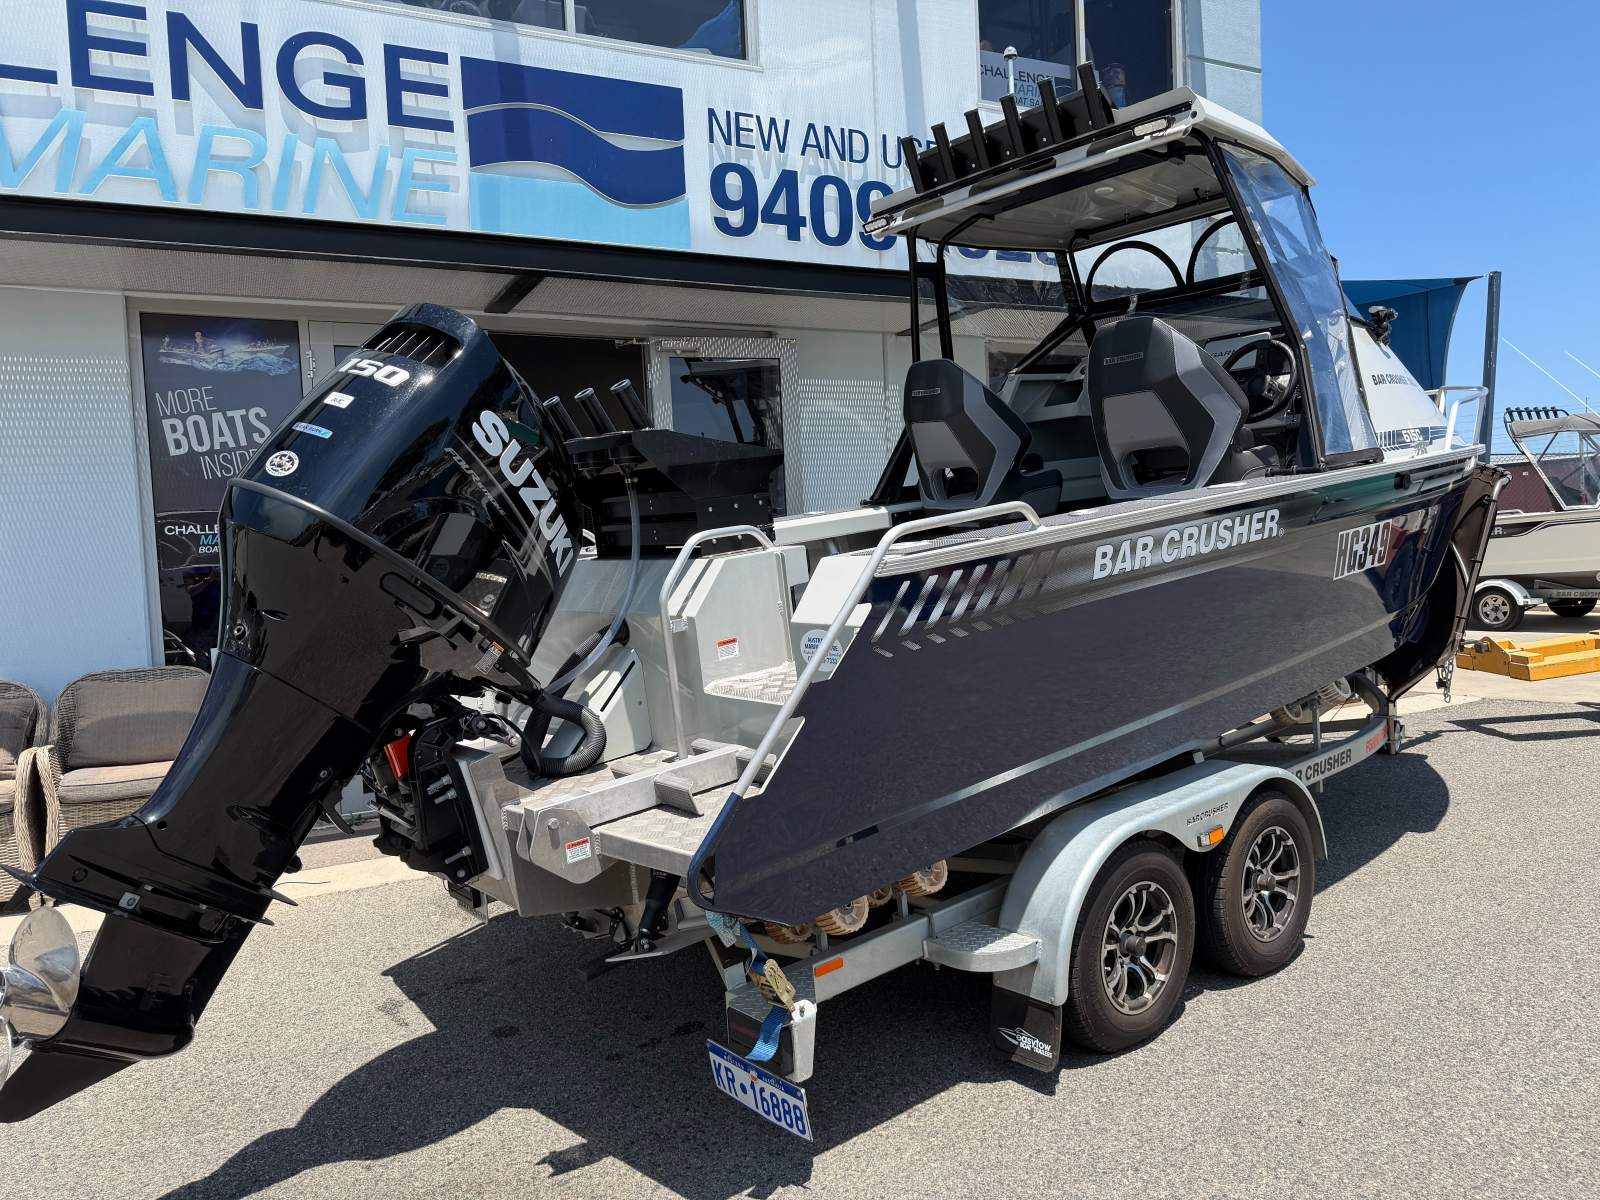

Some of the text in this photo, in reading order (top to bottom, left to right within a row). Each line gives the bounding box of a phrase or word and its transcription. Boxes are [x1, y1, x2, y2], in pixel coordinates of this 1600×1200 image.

[708, 108, 790, 154] NEW
[800, 121, 870, 164] AND
[0, 108, 458, 226] MARINE
[339, 358, 411, 387] 150
[155, 386, 217, 416] MORE
[161, 407, 272, 457] BOATS
[472, 410, 573, 578] SUZUKI
[1092, 509, 1280, 580] BAR CRUSHER
[1334, 520, 1391, 580] HG349
[1305, 749, 1352, 781] CRUSHER
[1016, 1034, 1052, 1052] easytow
